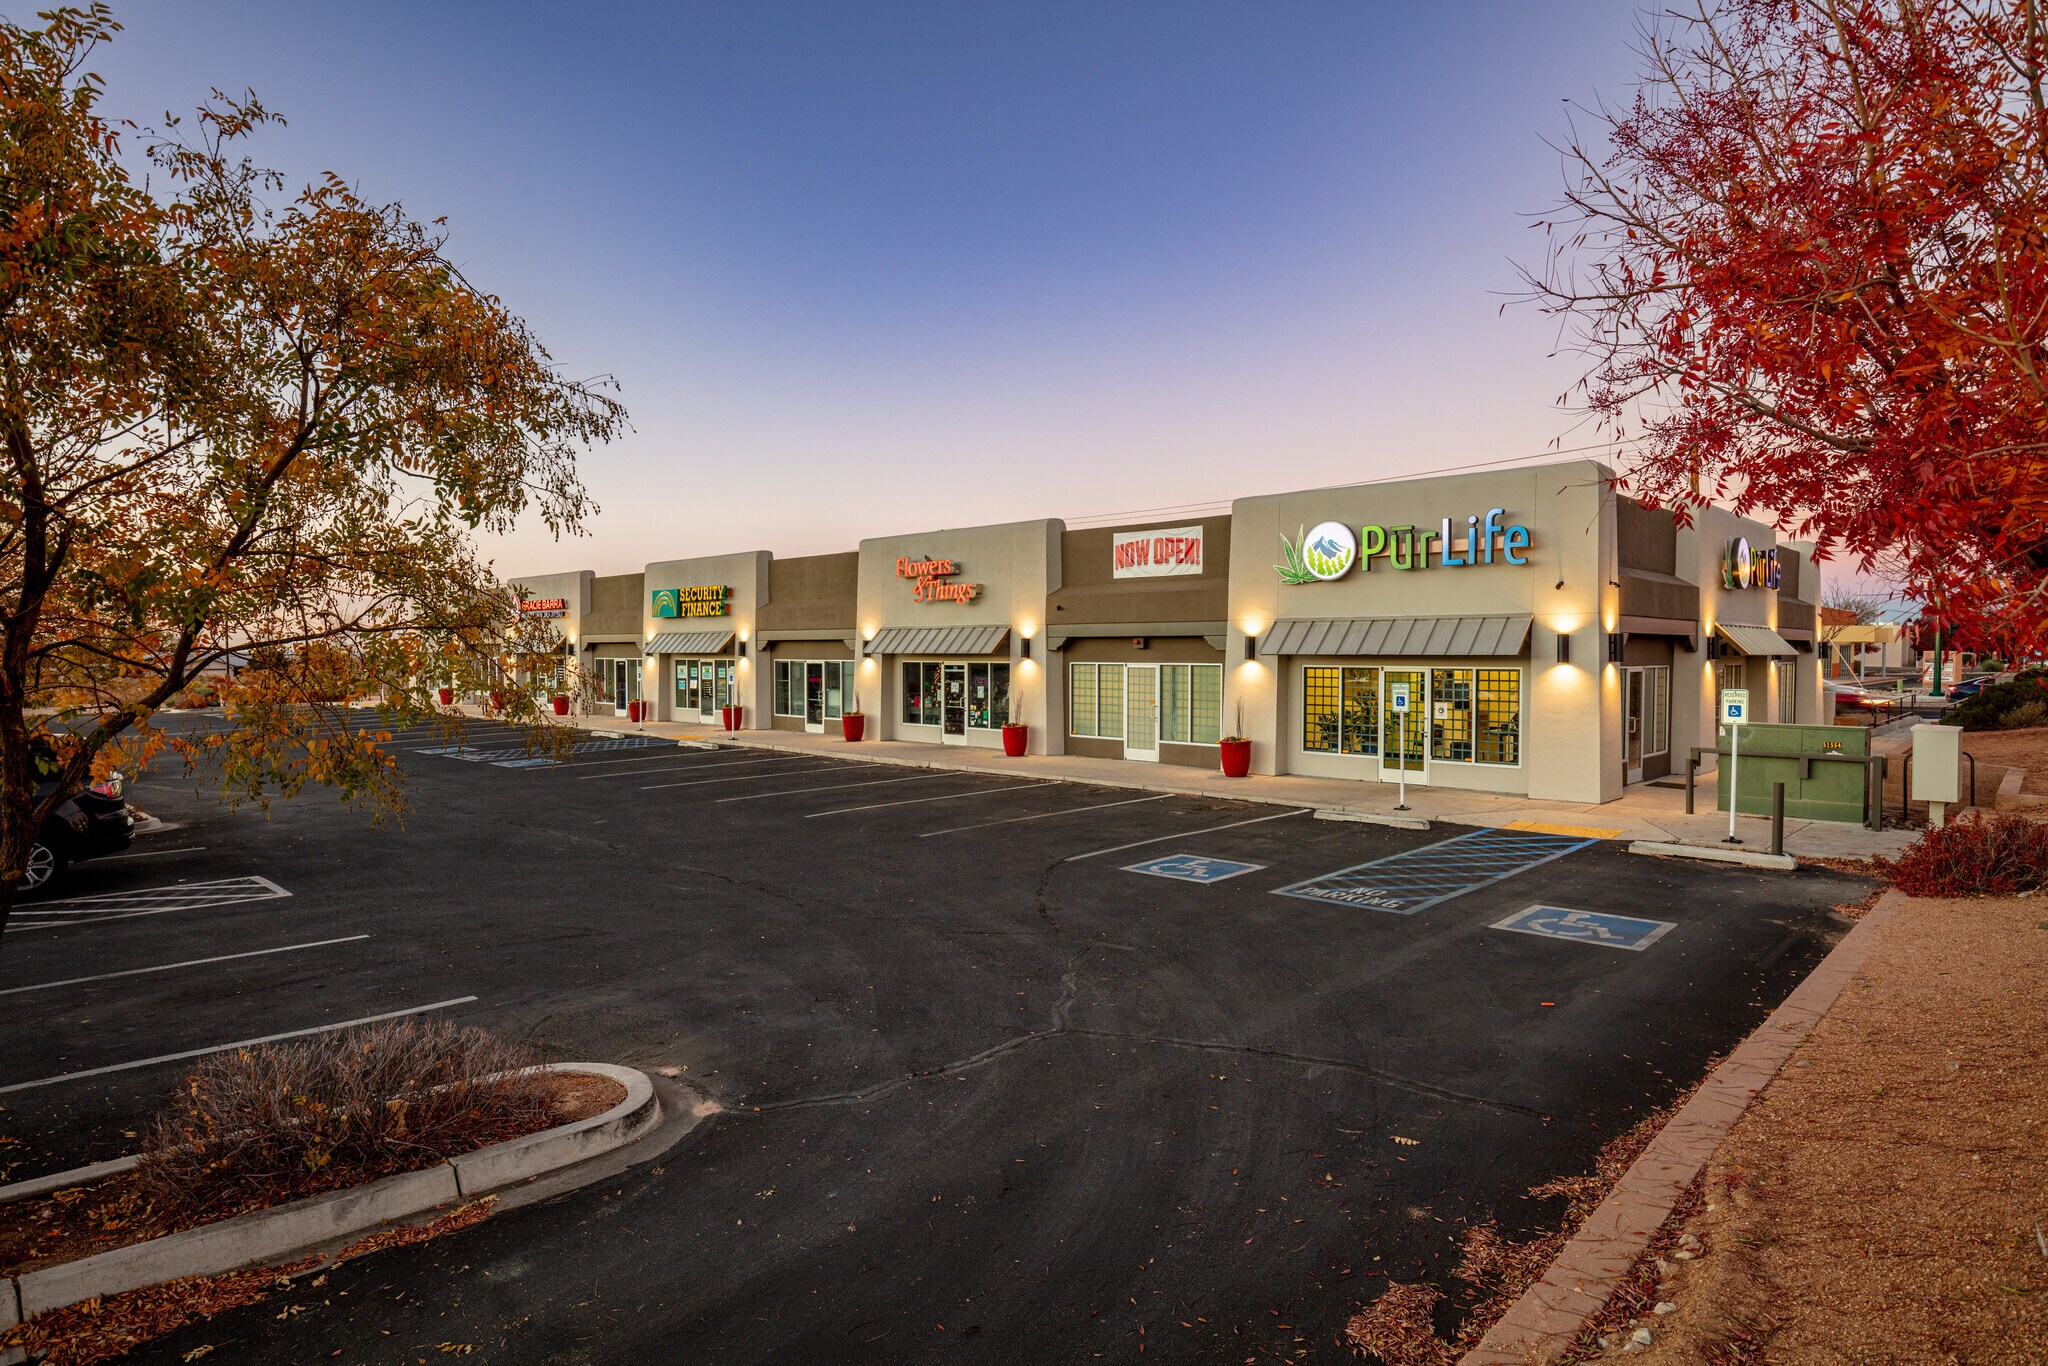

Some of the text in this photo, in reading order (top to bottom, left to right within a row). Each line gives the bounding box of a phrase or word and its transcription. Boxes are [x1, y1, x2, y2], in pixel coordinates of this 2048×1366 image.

[1115, 537, 1201, 570] NOW OPEN!
[896, 556, 951, 578] Flowers
[680, 585, 724, 602] SECURITY
[912, 575, 974, 605] & Things
[521, 598, 563, 611] GRACIE BARRA
[681, 601, 722, 617] FINANCE
[1296, 887, 1405, 909] PARKING
[1348, 886, 1388, 897] NO
